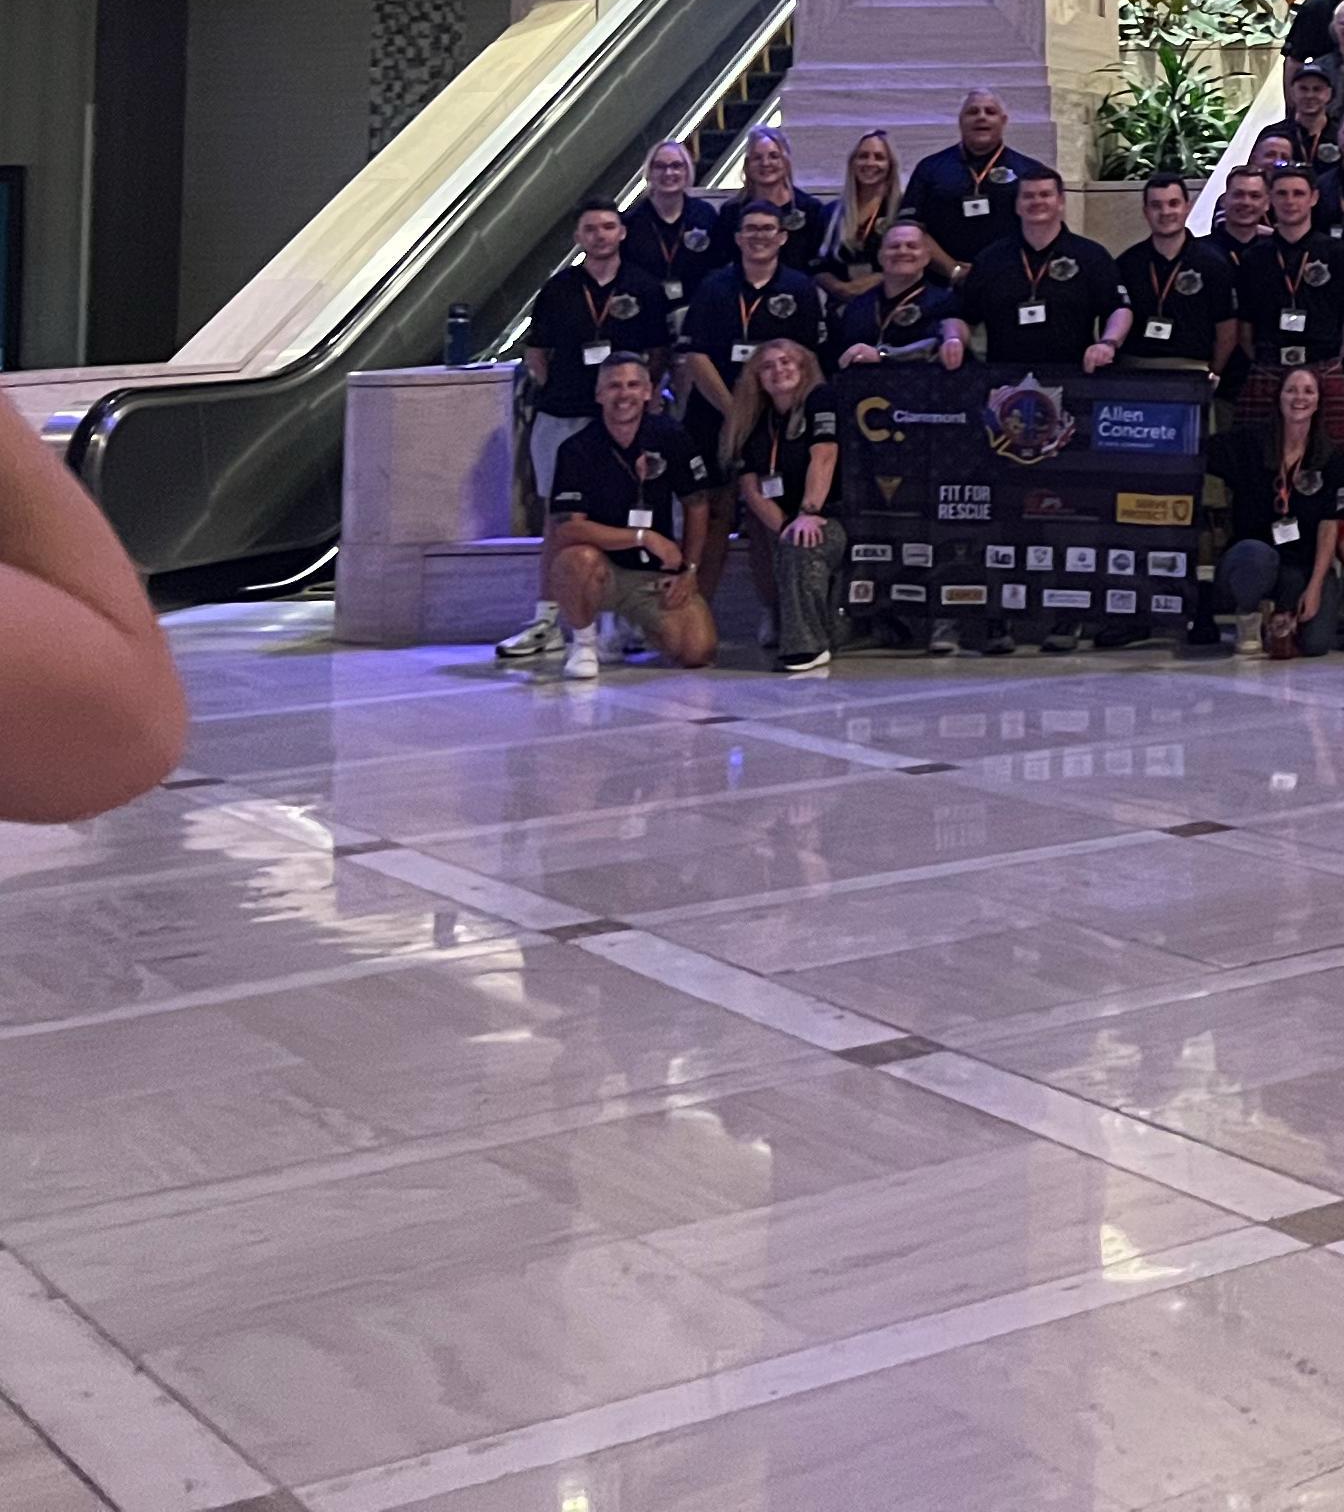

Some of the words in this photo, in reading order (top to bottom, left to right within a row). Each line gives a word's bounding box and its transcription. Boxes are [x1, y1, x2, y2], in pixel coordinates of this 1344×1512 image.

[1099, 406, 1144, 422] Allen
[1099, 422, 1177, 440] Concrete
[939, 484, 961, 502] FIT
[964, 485, 991, 502] FOR
[938, 502, 992, 520] RESCUE
